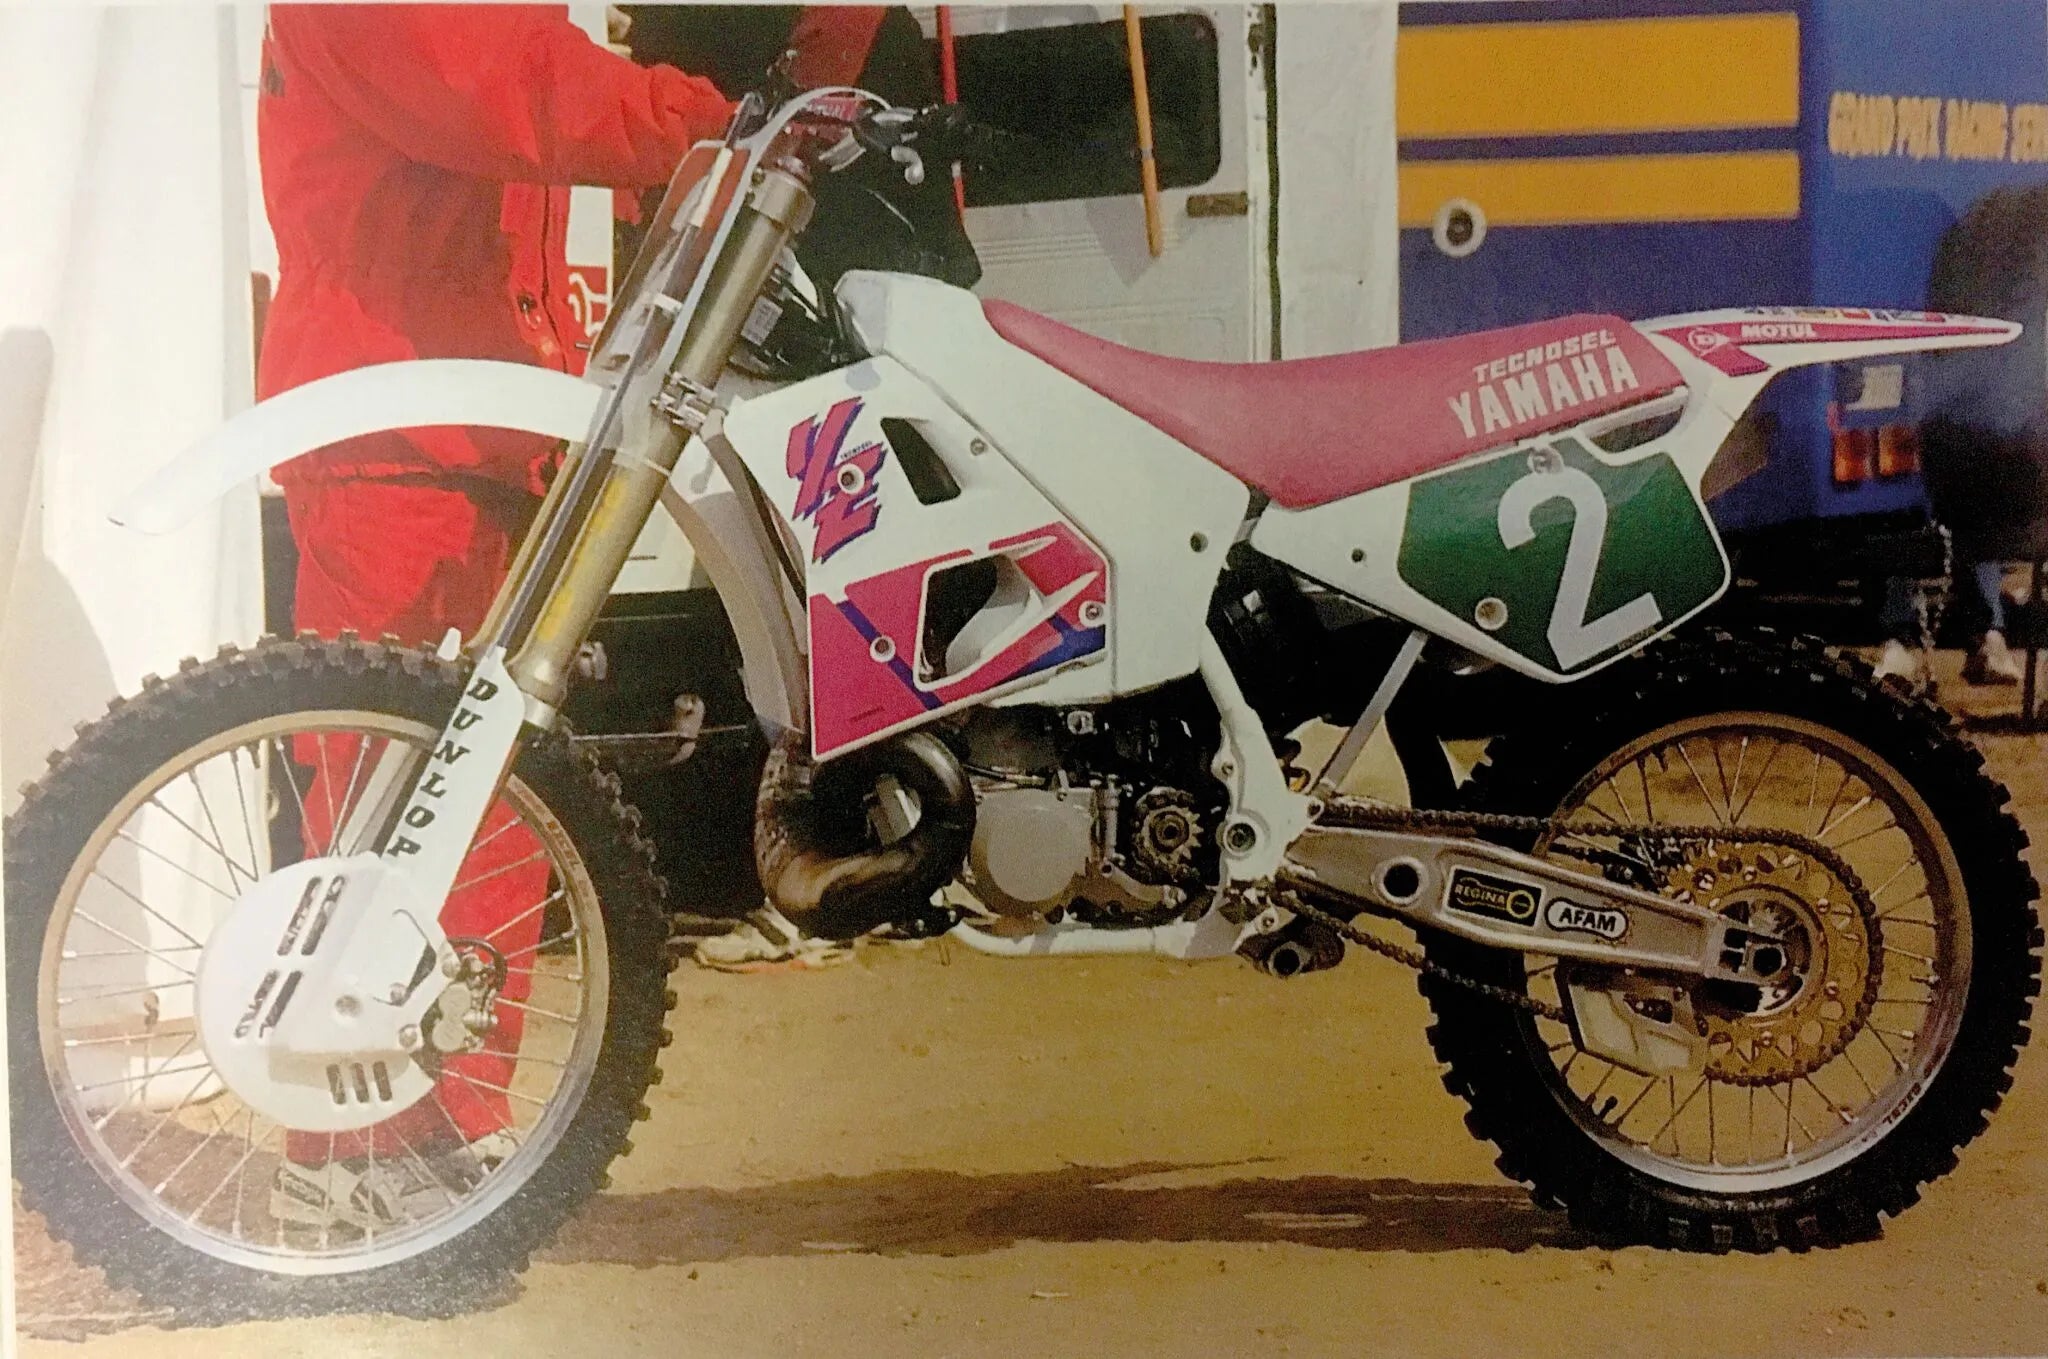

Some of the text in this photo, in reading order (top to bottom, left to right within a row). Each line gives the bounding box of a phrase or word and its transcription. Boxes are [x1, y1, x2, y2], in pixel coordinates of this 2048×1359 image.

[1741, 322, 1818, 343] MOTUL
[1448, 345, 1640, 438] YAMAHA
[1498, 465, 1663, 671] 2
[386, 677, 499, 857] DUNLOP
[1454, 884, 1507, 905] REGINA
[1558, 907, 1617, 932] AFAM
